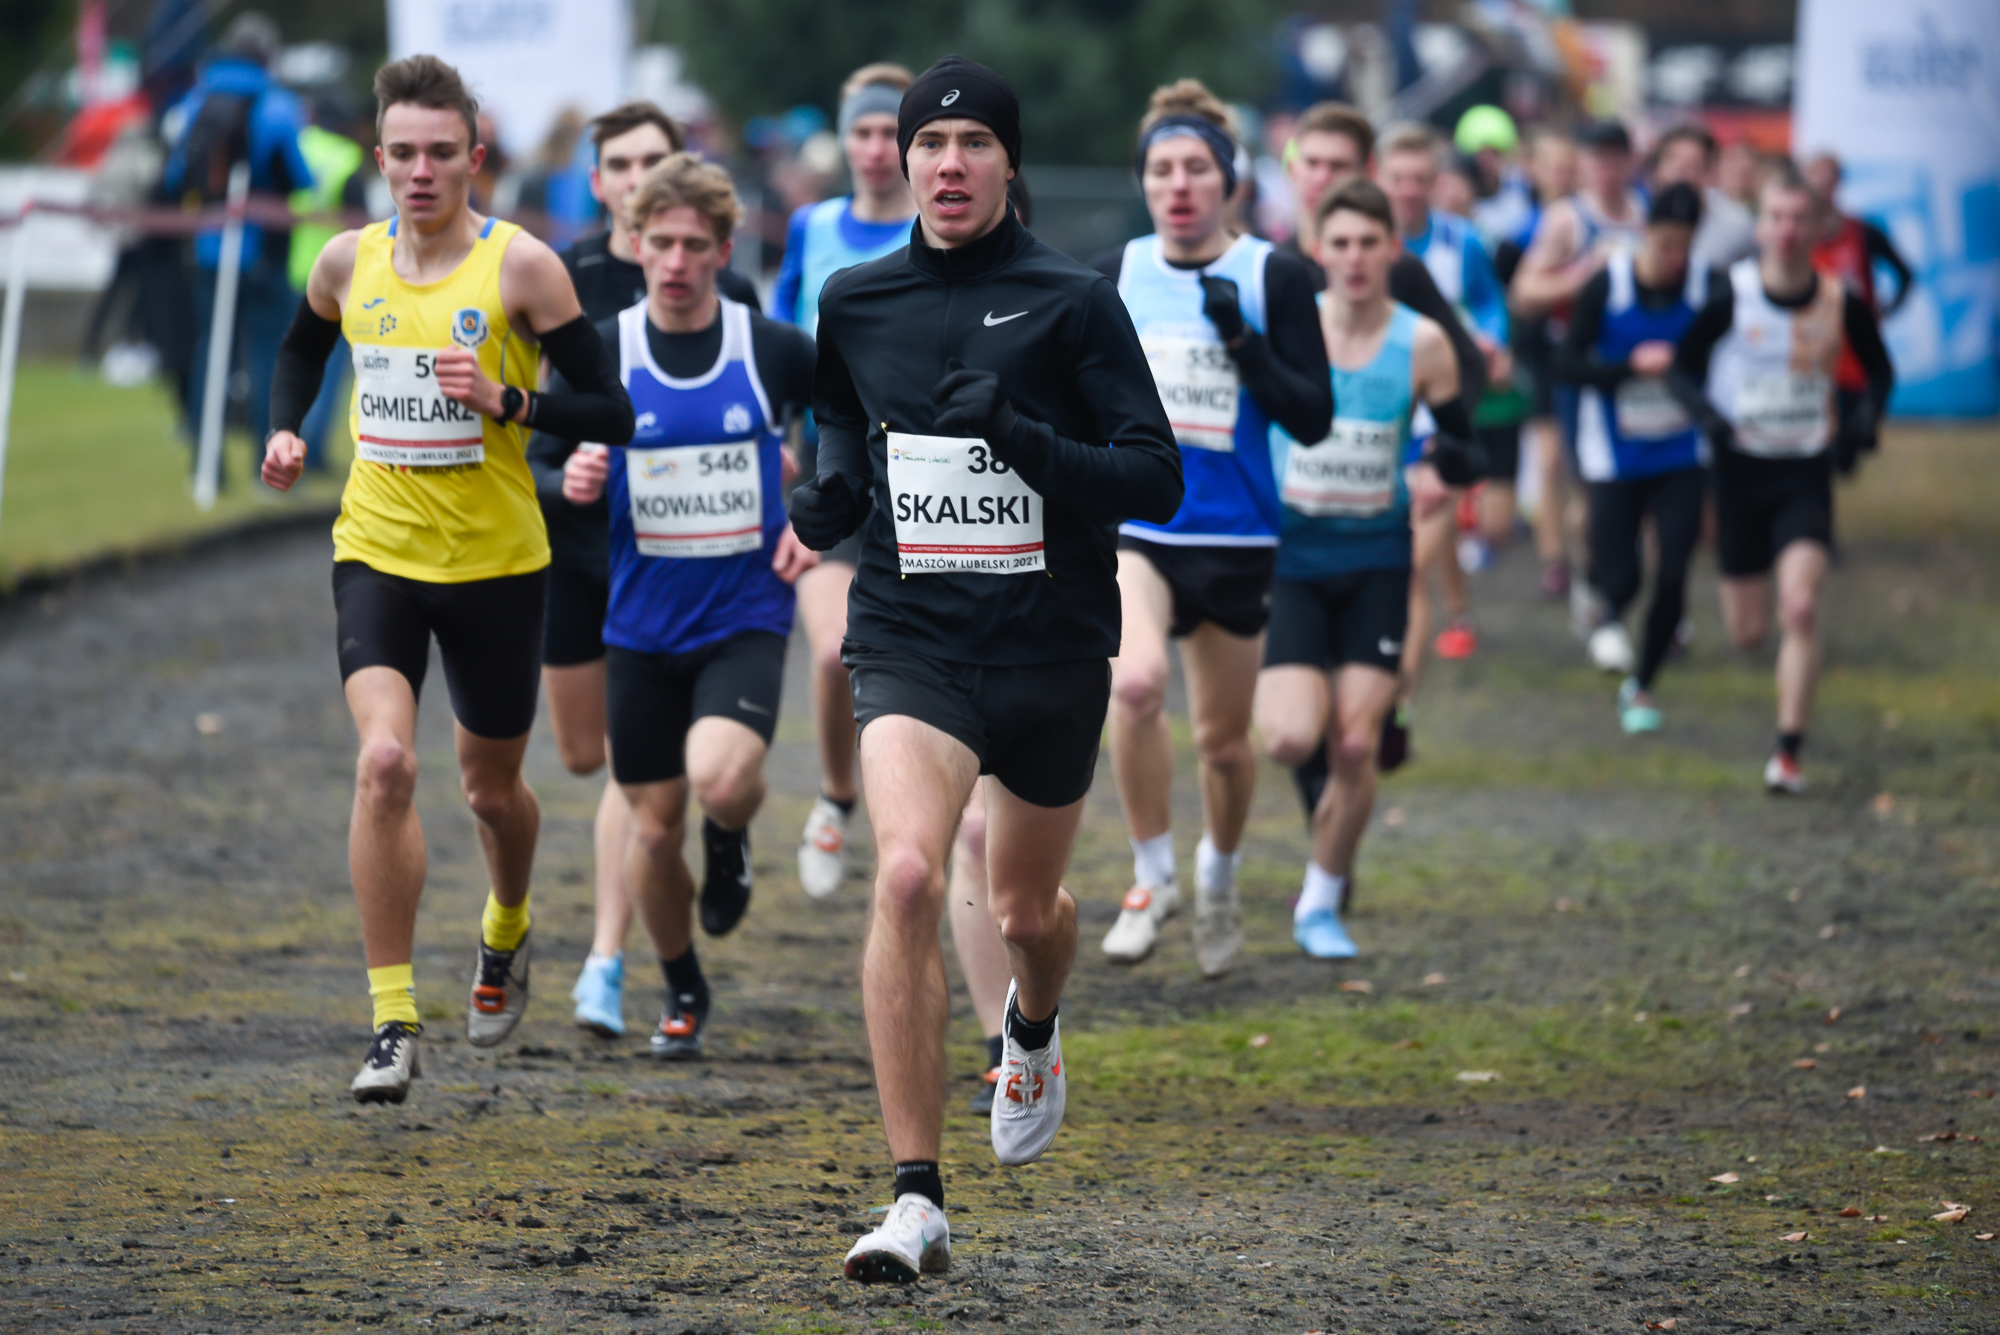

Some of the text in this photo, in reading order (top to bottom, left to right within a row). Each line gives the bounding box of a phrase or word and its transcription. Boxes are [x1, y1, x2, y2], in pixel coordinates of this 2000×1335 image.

[361, 394, 474, 422] CHMIELARZ
[699, 450, 748, 477] 546
[635, 490, 755, 519] KOWALSKI
[896, 493, 1030, 524] SKALSKI
[899, 556, 1038, 569] OMASZÓW LUBELSKI 2021
